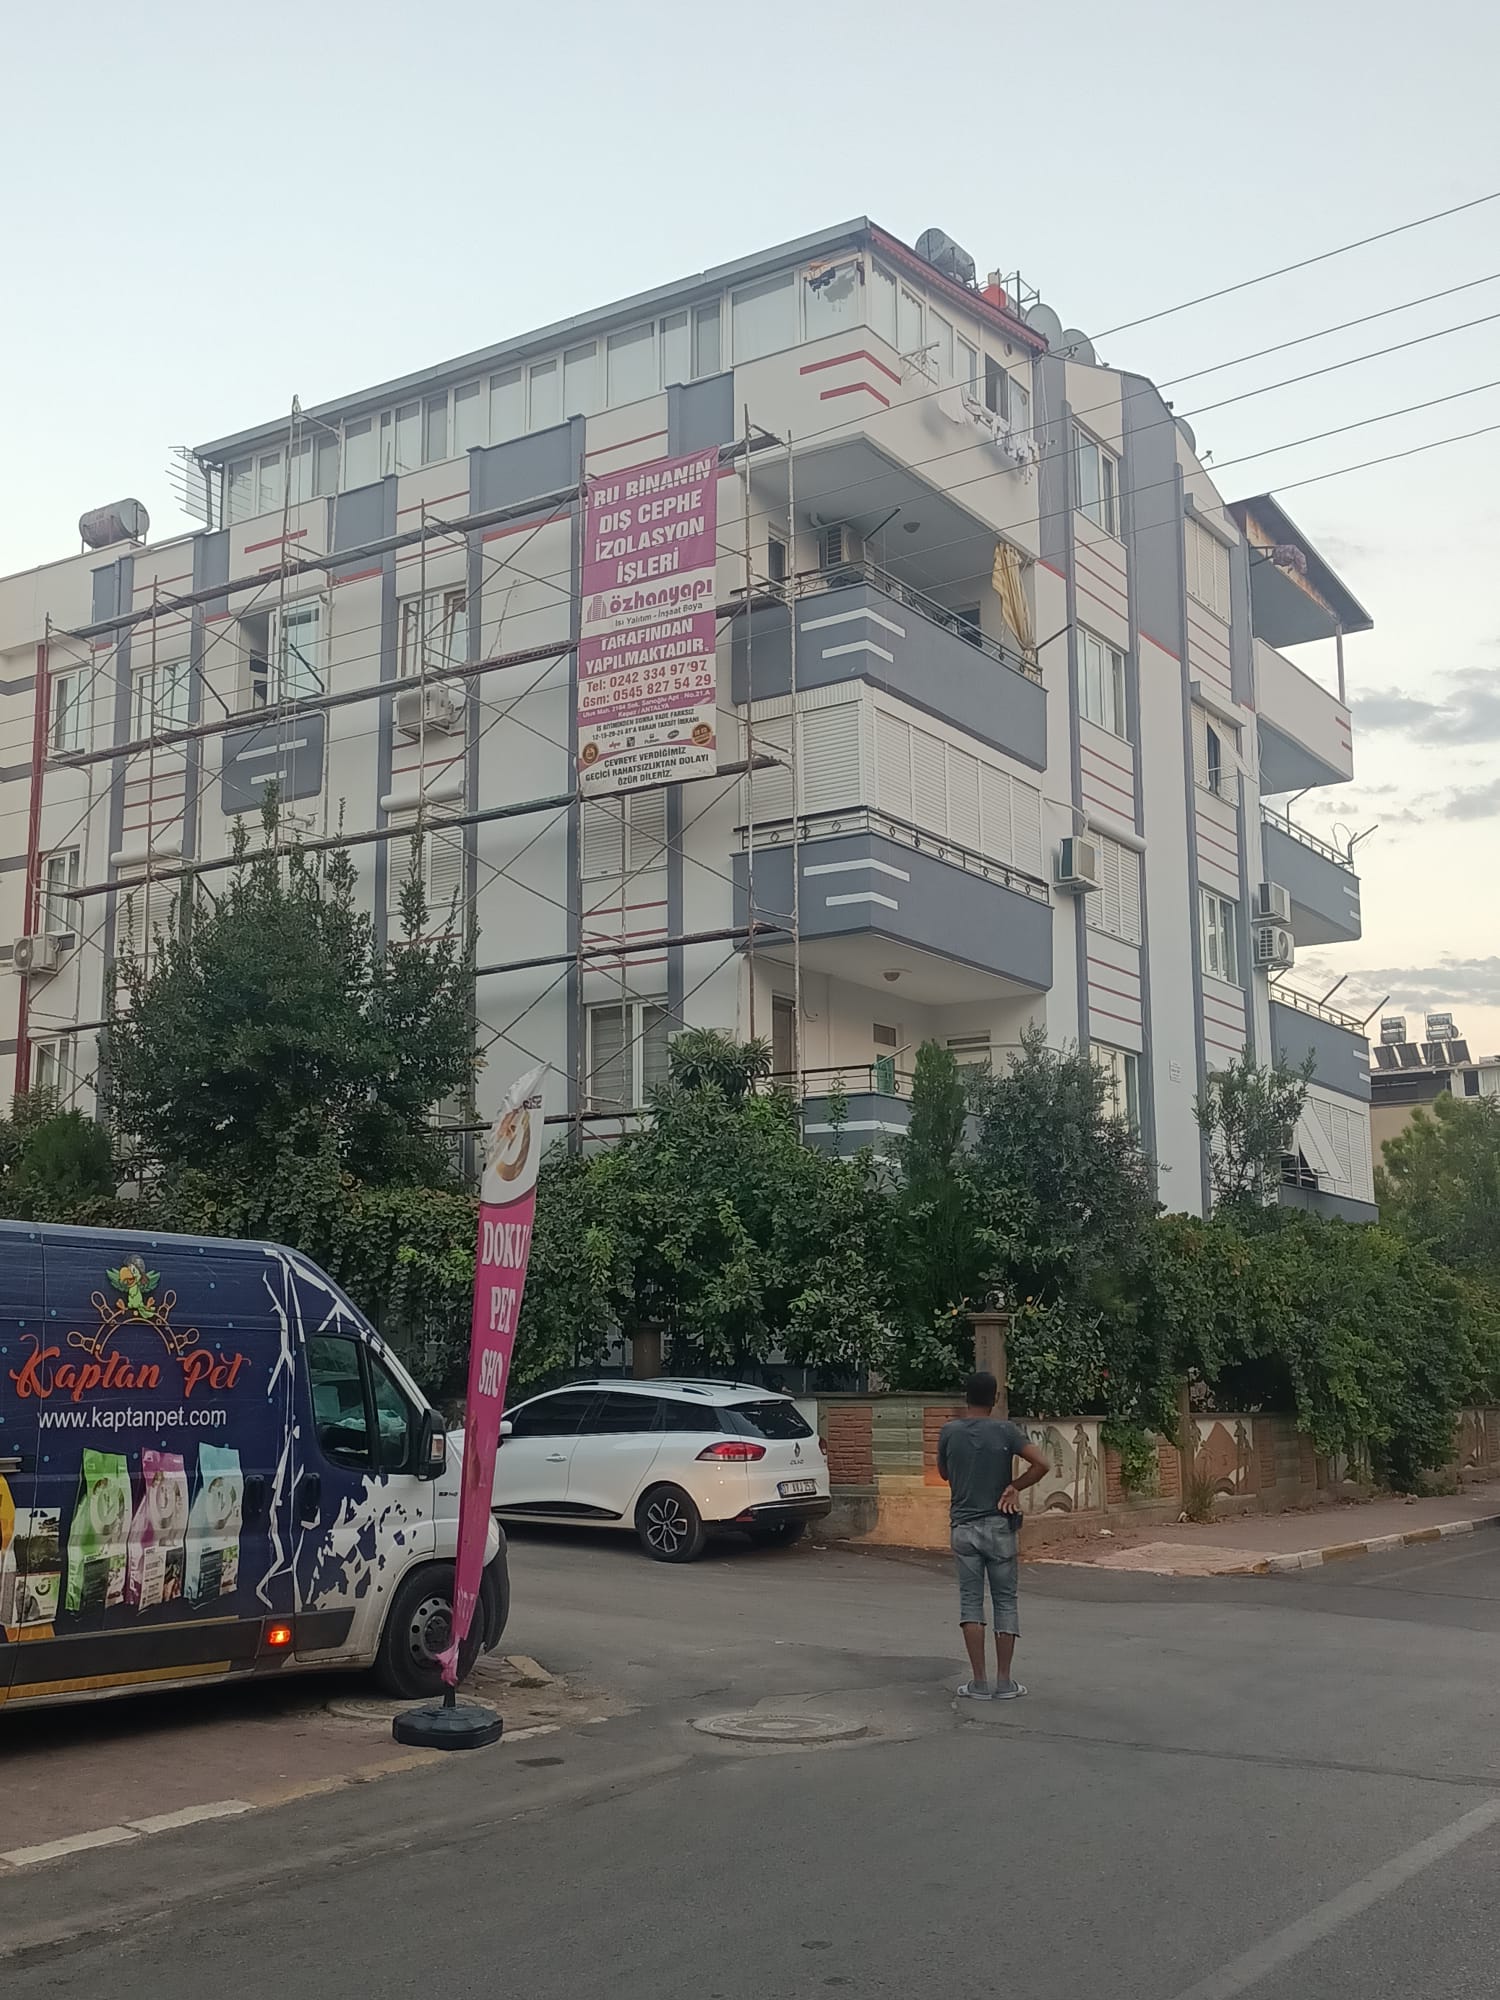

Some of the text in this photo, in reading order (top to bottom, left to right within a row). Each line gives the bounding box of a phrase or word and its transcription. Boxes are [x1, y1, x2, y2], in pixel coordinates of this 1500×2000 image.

[626, 458, 711, 500] BİNANIN
[599, 489, 702, 534] DIŞ CEPHE
[595, 516, 705, 562] İZOLASYON
[616, 547, 680, 584] İŞLERİ
[610, 579, 713, 613] özhanyapı
[683, 602, 703, 612] Boya
[601, 618, 693, 651] TARAFINDAN
[586, 638, 710, 675] YAPILMAKTADIR.
[583, 673, 712, 708] Gsm: 0545 827 54 29
[587, 680, 606, 693] Tel:
[609, 672, 639, 688] 0242
[643, 666, 666, 681] 334
[641, 703, 670, 713] ANTALYA
[585, 753, 709, 782] GEÇİCİ RAHATSIZLIKTAN DOLAYI
[604, 754, 637, 768] ÇEVREYE
[639, 746, 687, 761] VERDİĞİMİZ
[618, 774, 638, 786] ÖZÜR
[481, 1220, 530, 1270] DOKU
[489, 1286, 516, 1334] PET
[9, 1333, 252, 1404] Kaptan Pet
[38, 1406, 227, 1433] www.kaptanpet.com
